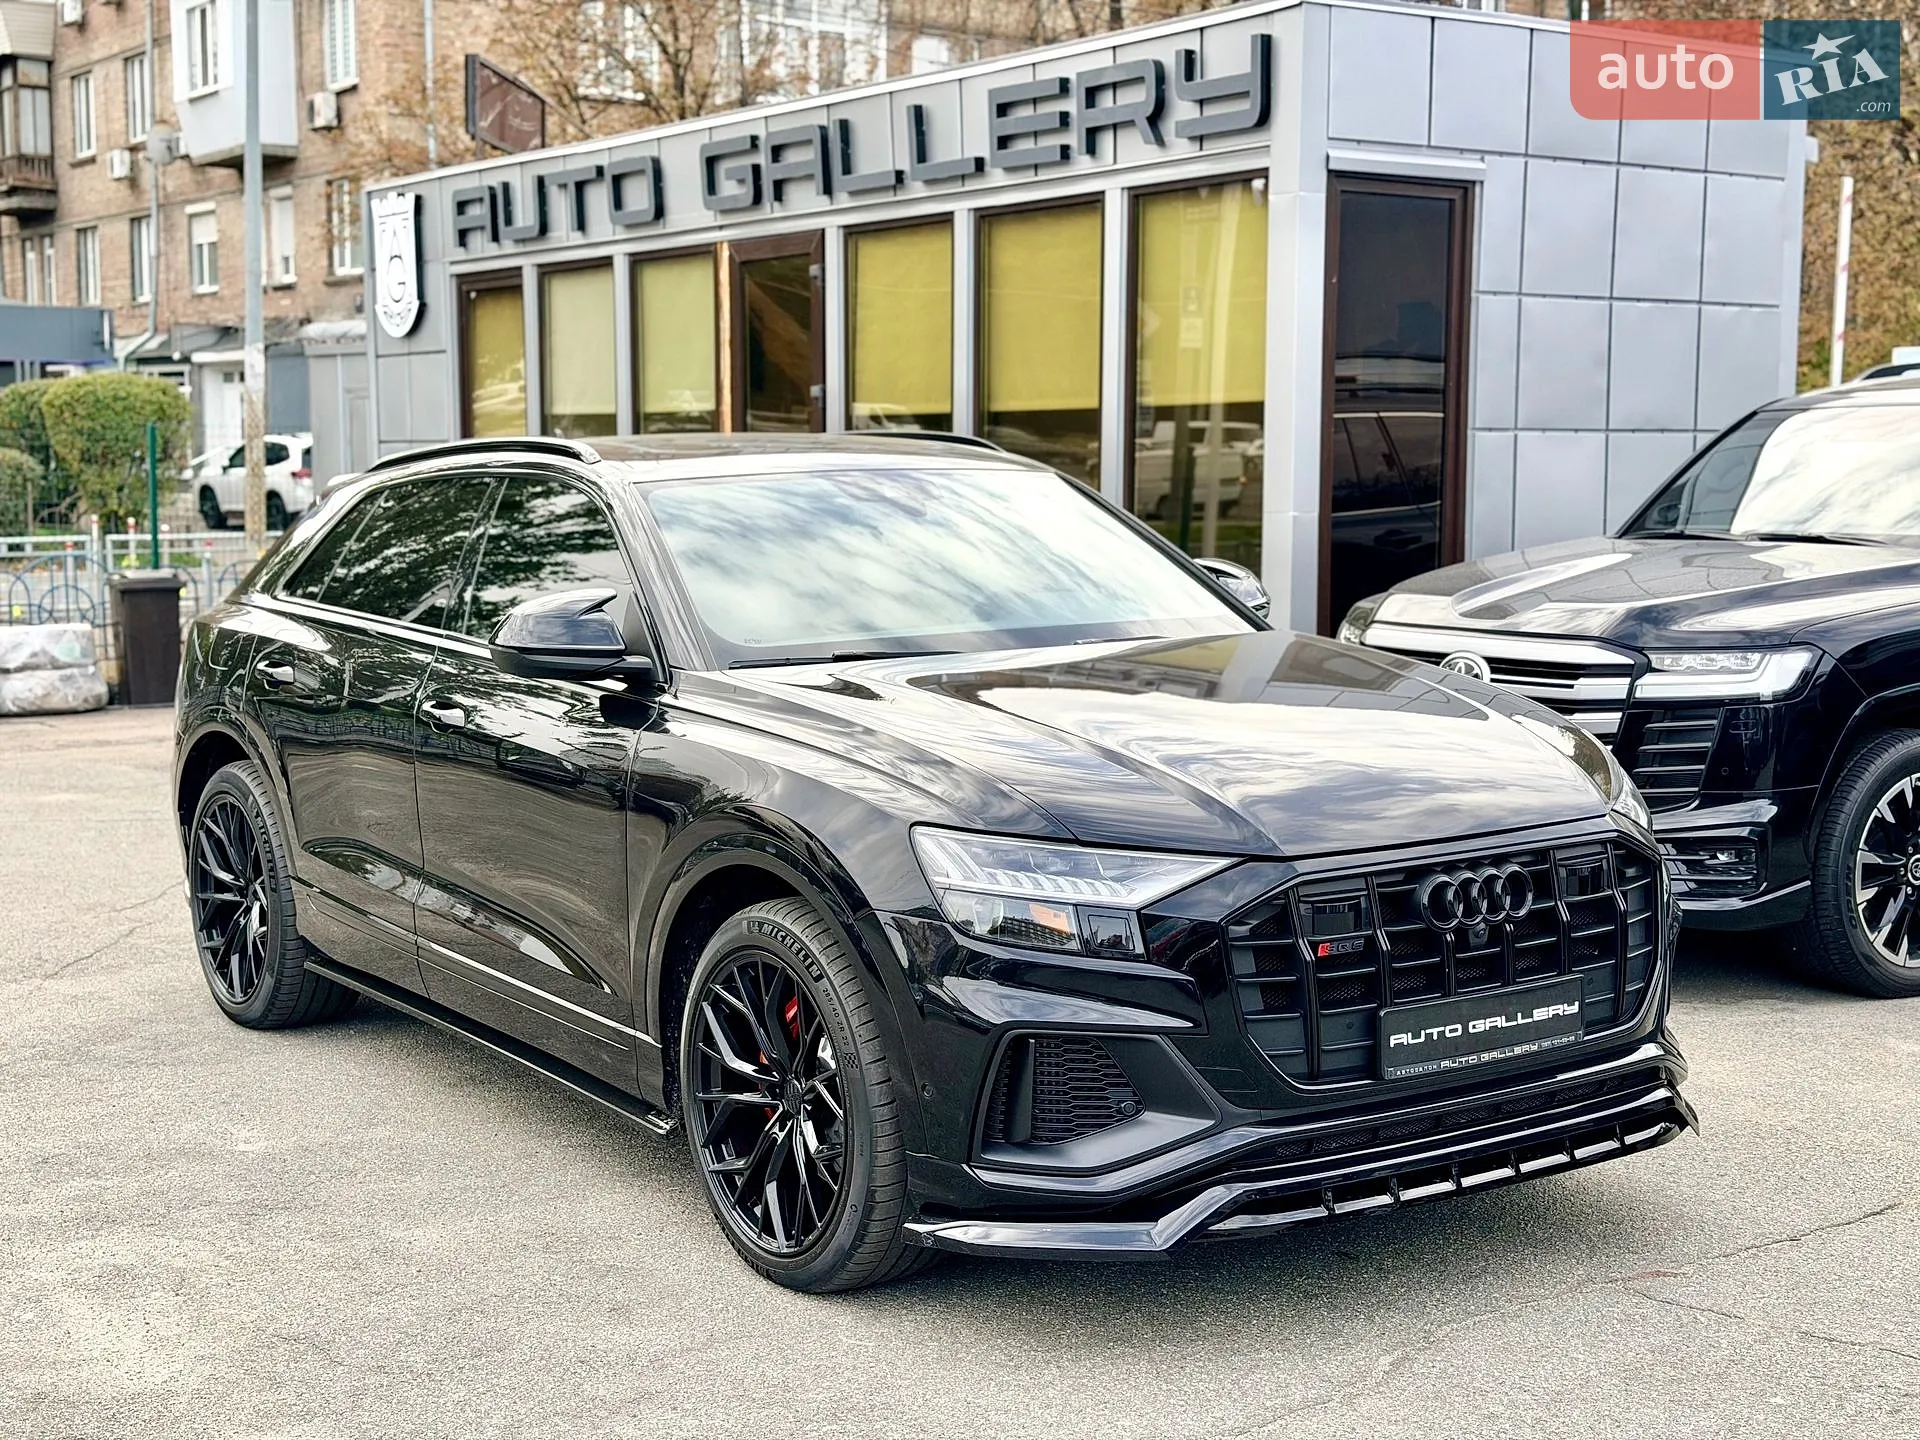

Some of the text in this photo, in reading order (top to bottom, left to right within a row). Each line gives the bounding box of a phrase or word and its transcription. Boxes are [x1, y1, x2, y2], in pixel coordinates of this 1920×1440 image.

[452, 33, 1272, 250] AUTO GALLERY
[761, 924, 822, 978] MICHELIN
[1389, 1001, 1580, 1048] AUTO GALLERY
[1440, 1055, 1478, 1070] AUTO
[1481, 1042, 1539, 1062] GALLERY
